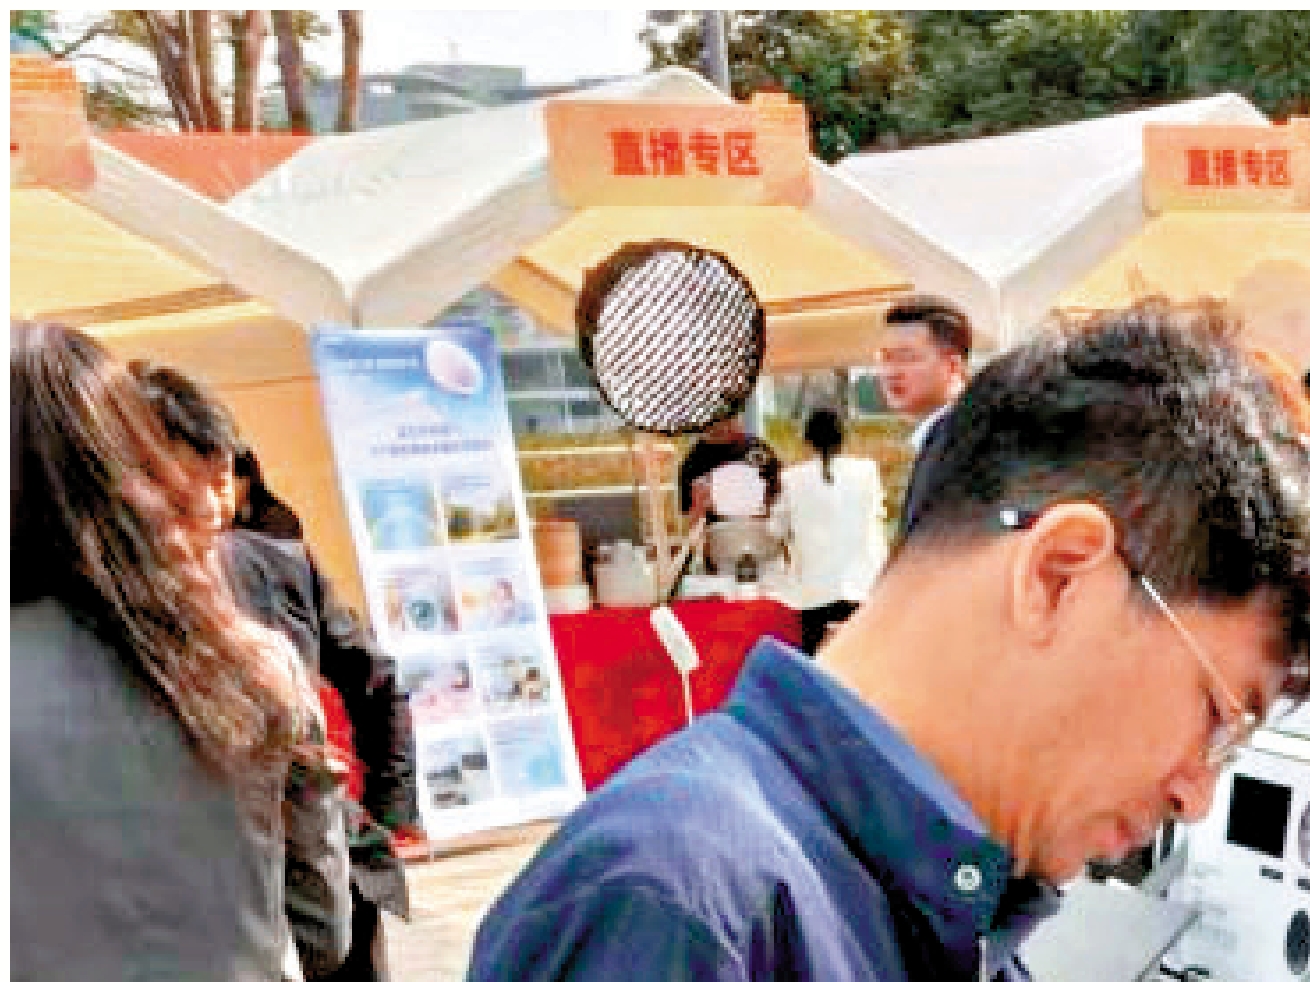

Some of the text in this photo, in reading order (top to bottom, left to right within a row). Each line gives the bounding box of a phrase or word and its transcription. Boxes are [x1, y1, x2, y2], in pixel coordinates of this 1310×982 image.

[608, 129, 762, 176] 直播专区
[1185, 148, 1292, 188] 直播专区
